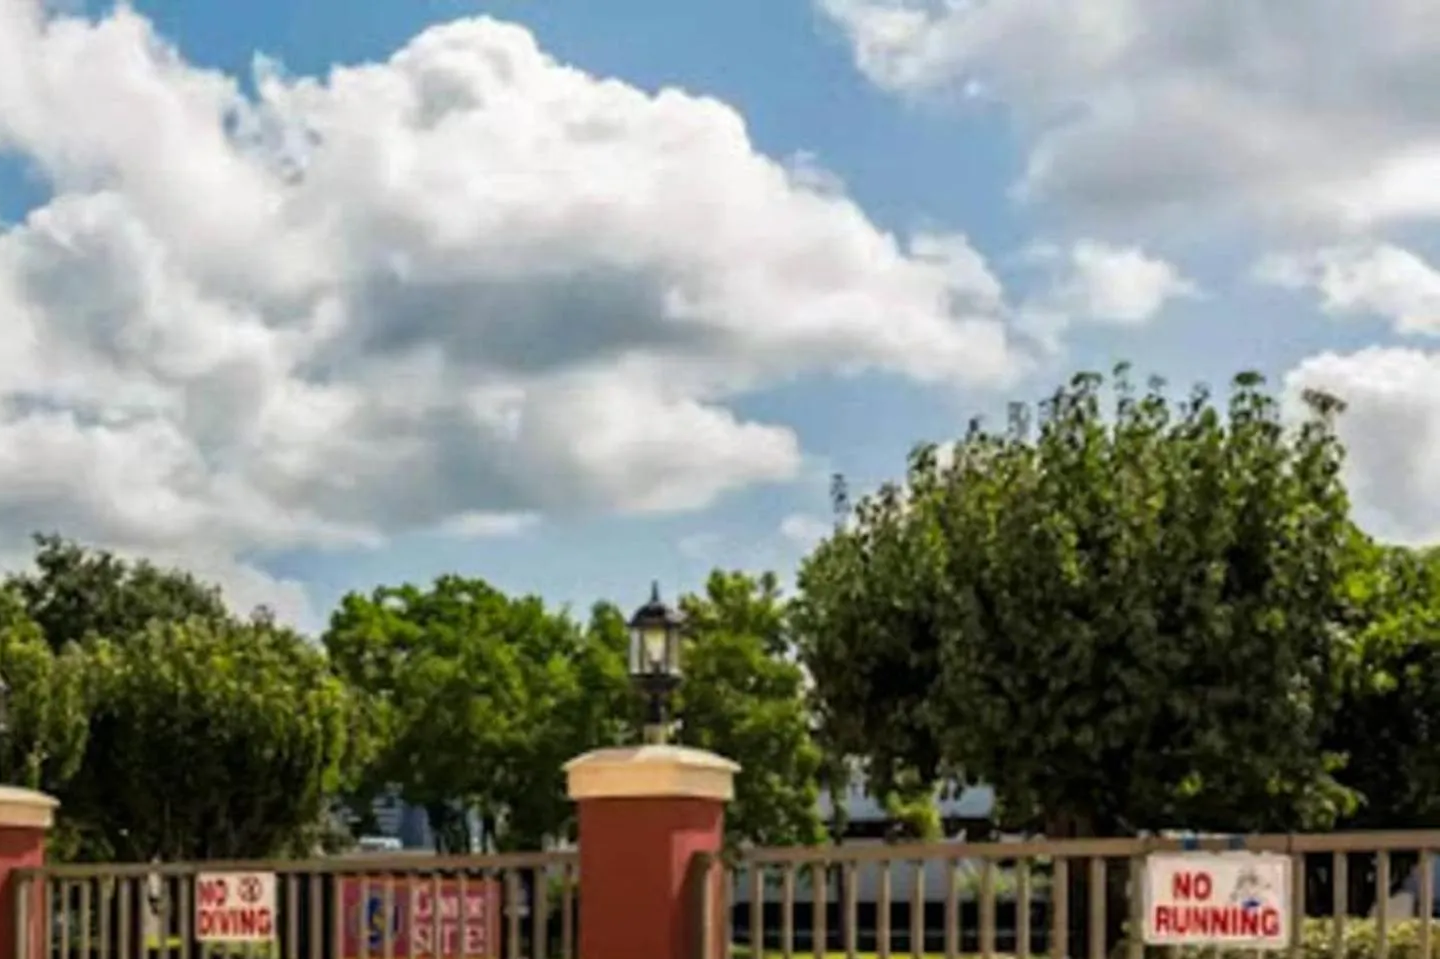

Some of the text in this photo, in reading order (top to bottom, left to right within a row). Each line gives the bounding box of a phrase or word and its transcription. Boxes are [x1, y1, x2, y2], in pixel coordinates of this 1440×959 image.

[198, 879, 227, 907] NO
[1173, 872, 1212, 900] NO
[198, 908, 271, 936] DIVING
[1155, 905, 1279, 936] RUNNING
